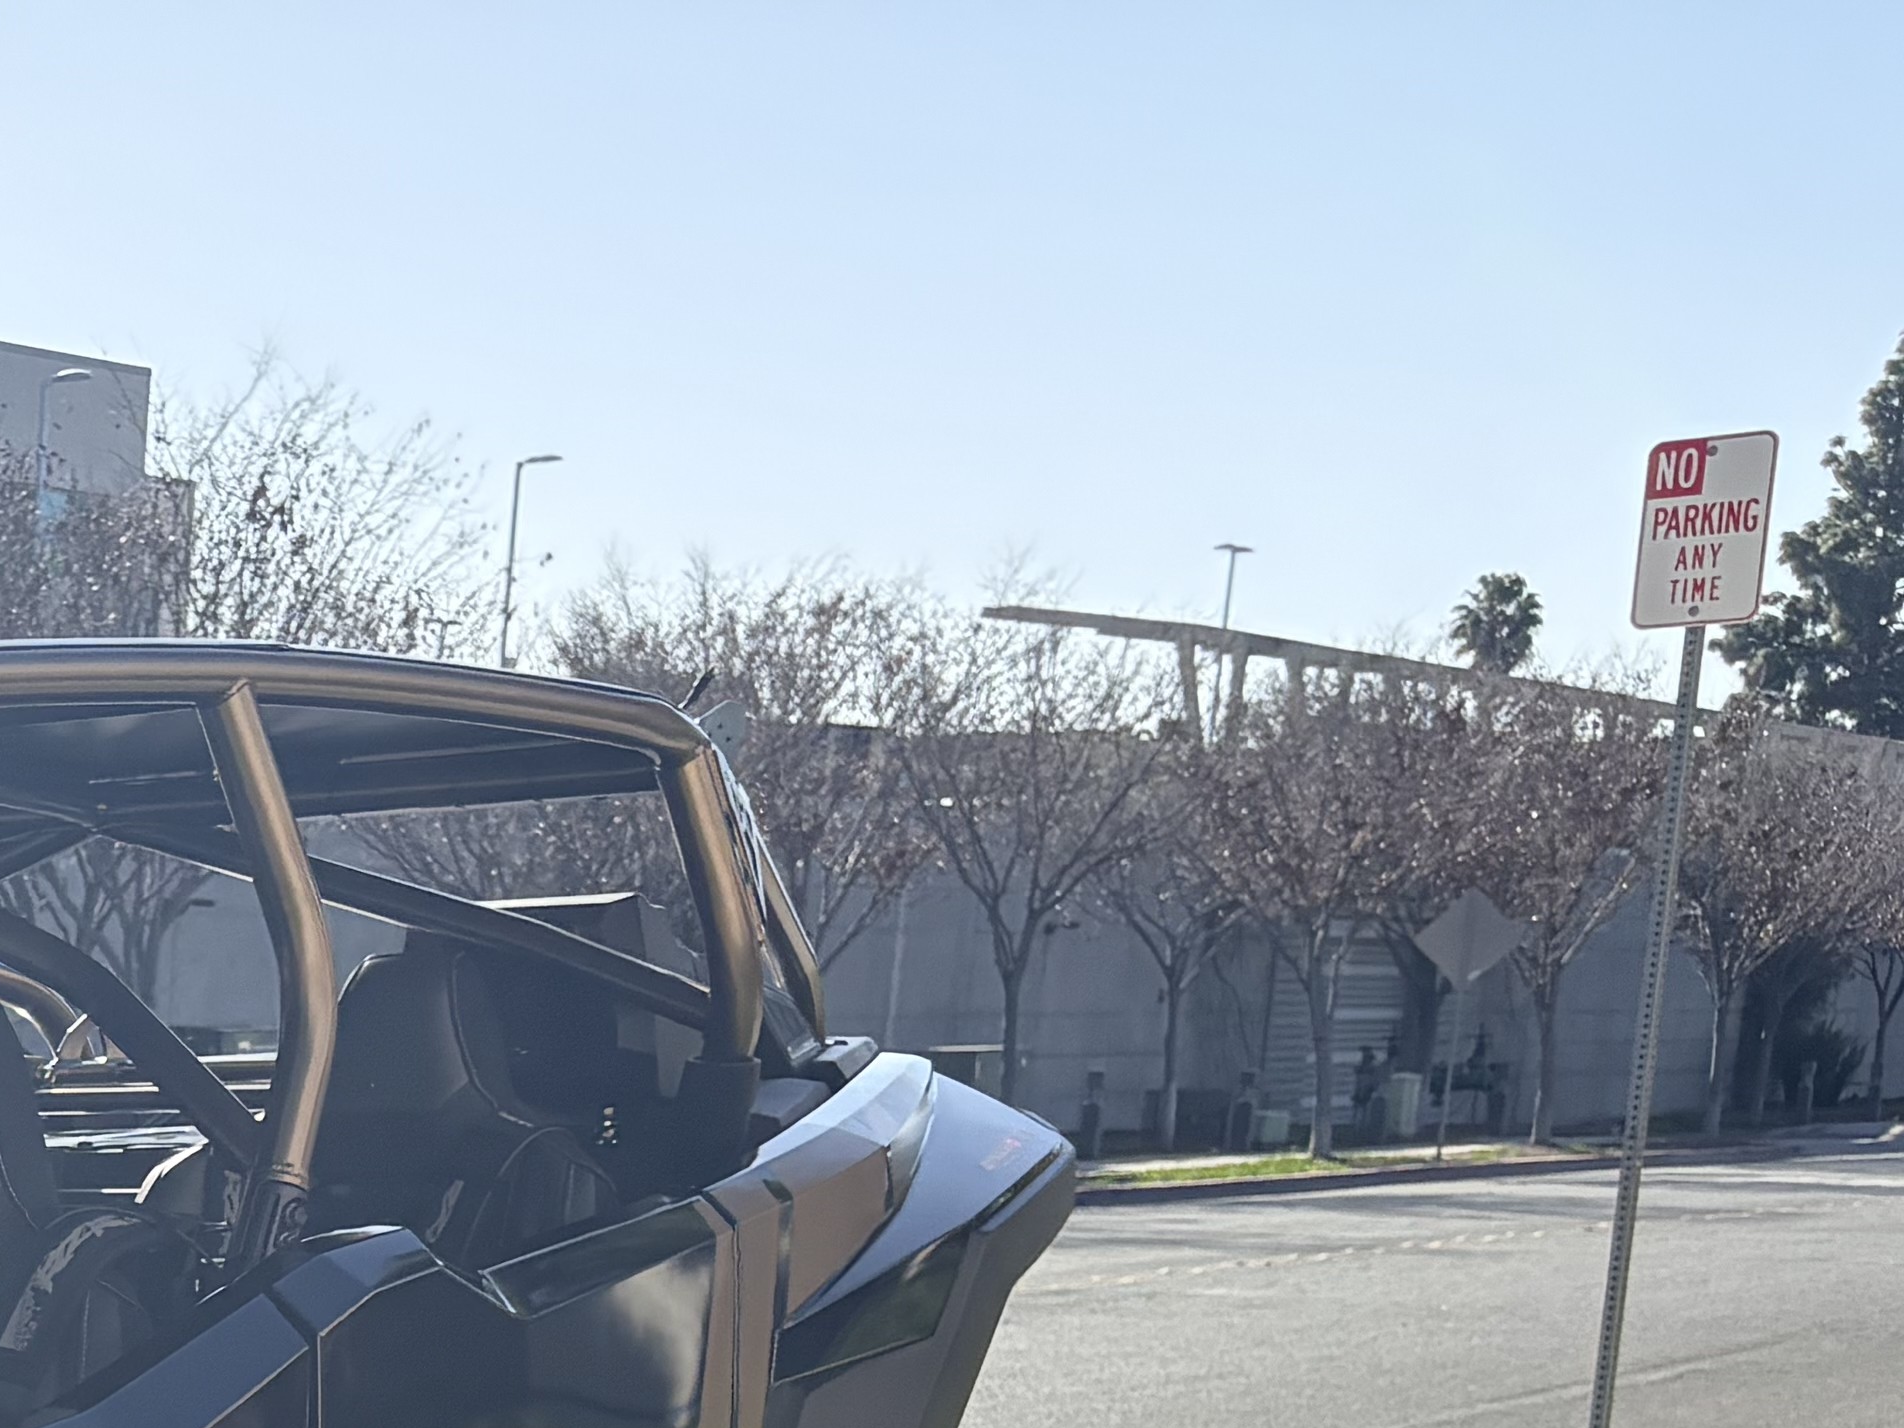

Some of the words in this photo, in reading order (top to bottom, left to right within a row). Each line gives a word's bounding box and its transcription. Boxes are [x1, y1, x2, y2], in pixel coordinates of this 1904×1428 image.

[1655, 447, 1699, 491] NO
[1651, 498, 1760, 541] PARKING
[1674, 543, 1723, 572] ANY
[1670, 576, 1722, 604] TIME
